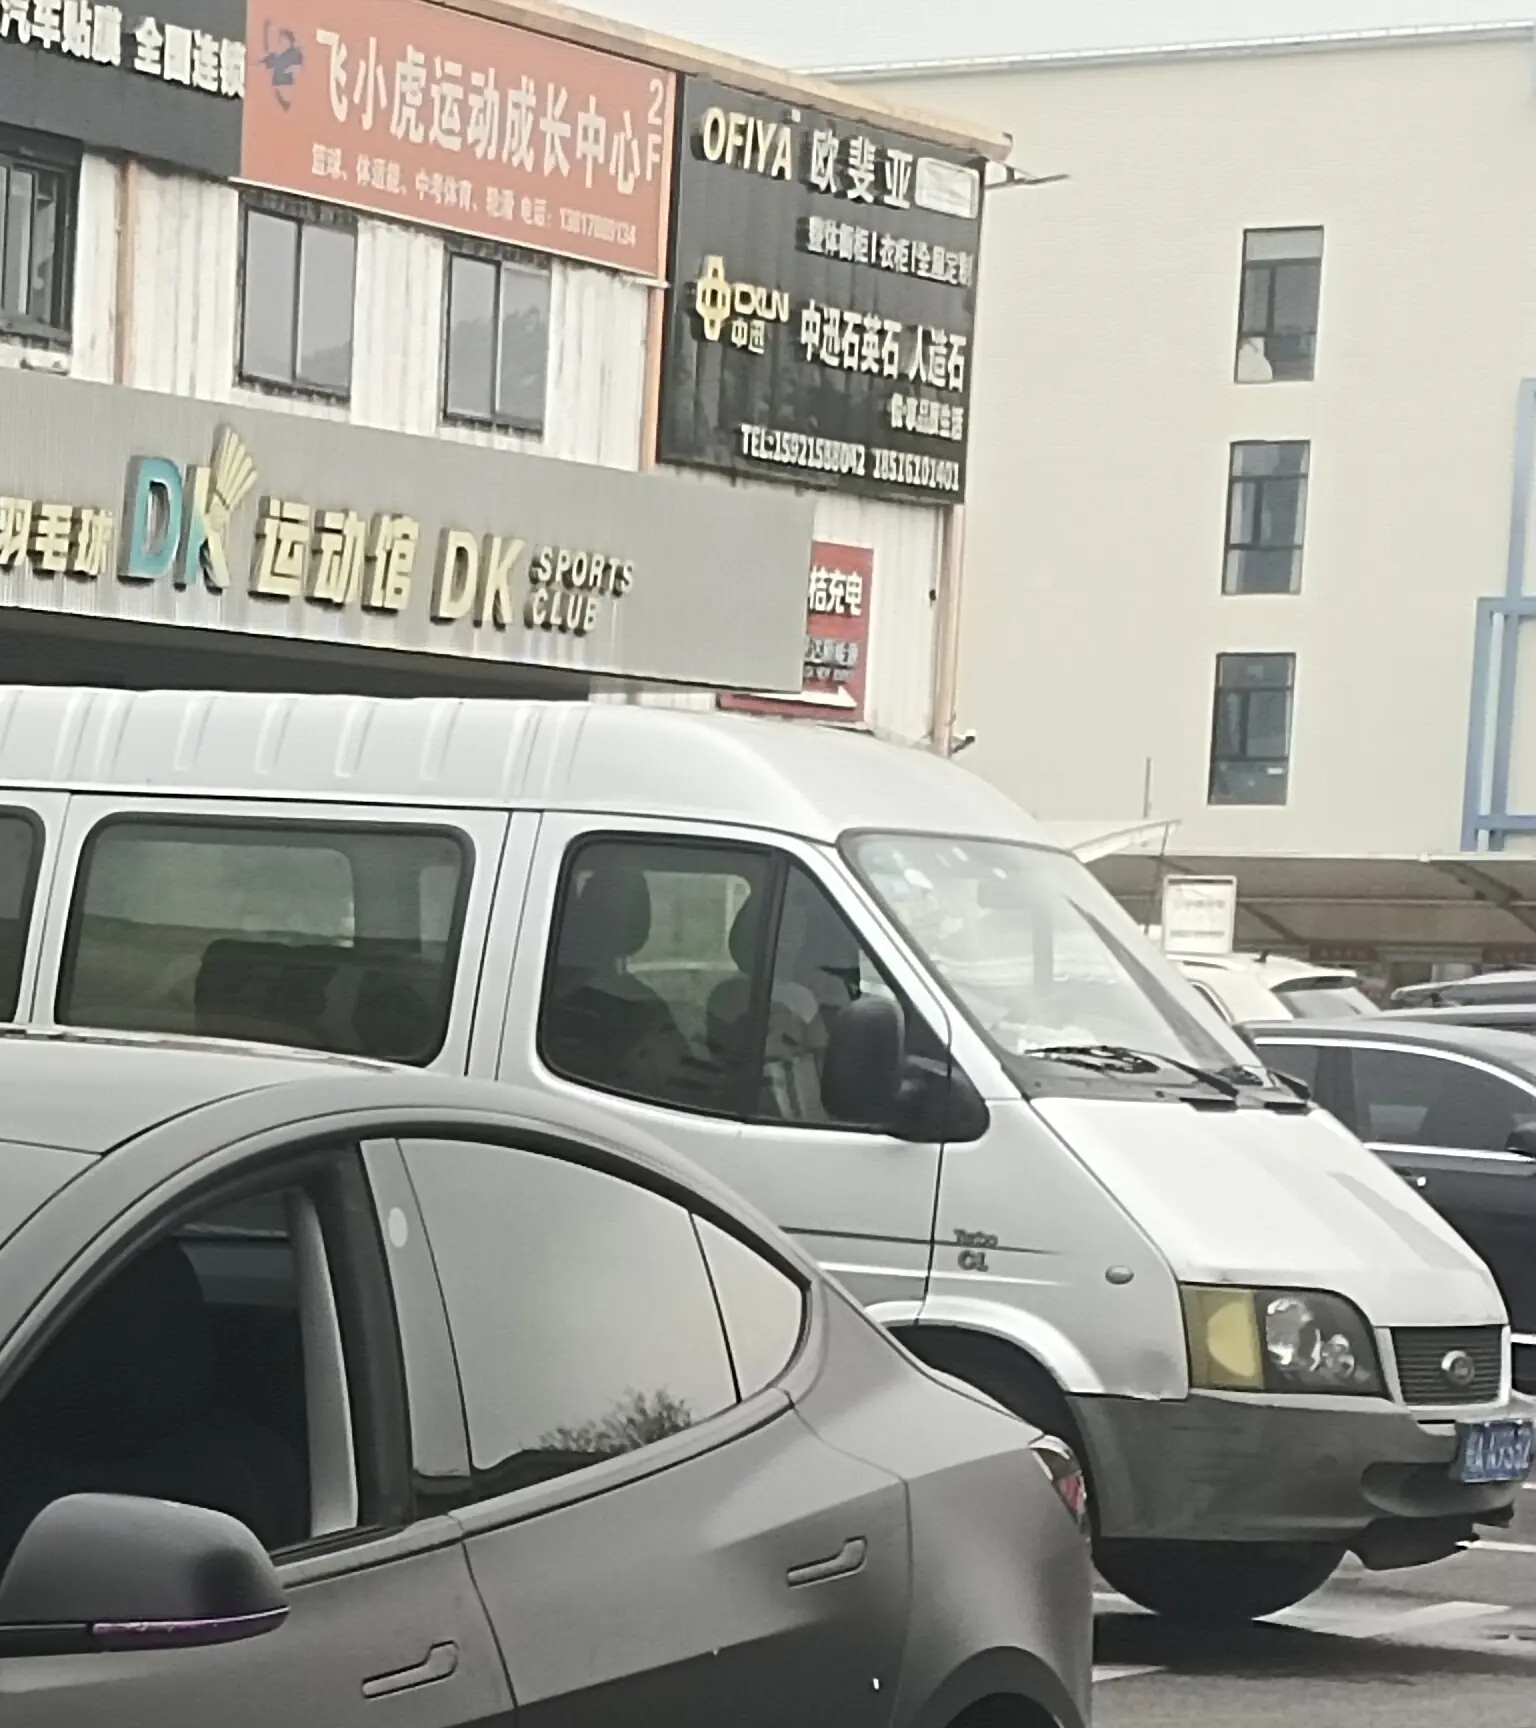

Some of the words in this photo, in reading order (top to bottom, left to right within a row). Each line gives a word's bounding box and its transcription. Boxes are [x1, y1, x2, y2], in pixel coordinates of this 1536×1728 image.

[316, 28, 640, 195] 飞小虎运动成长中心
[703, 106, 792, 181] OFIYA
[908, 325, 967, 393] 人造石
[252, 497, 419, 610] 运动馆
[434, 528, 526, 625] DK
[534, 545, 636, 594] SPORTS
[531, 587, 600, 632] CLUB
